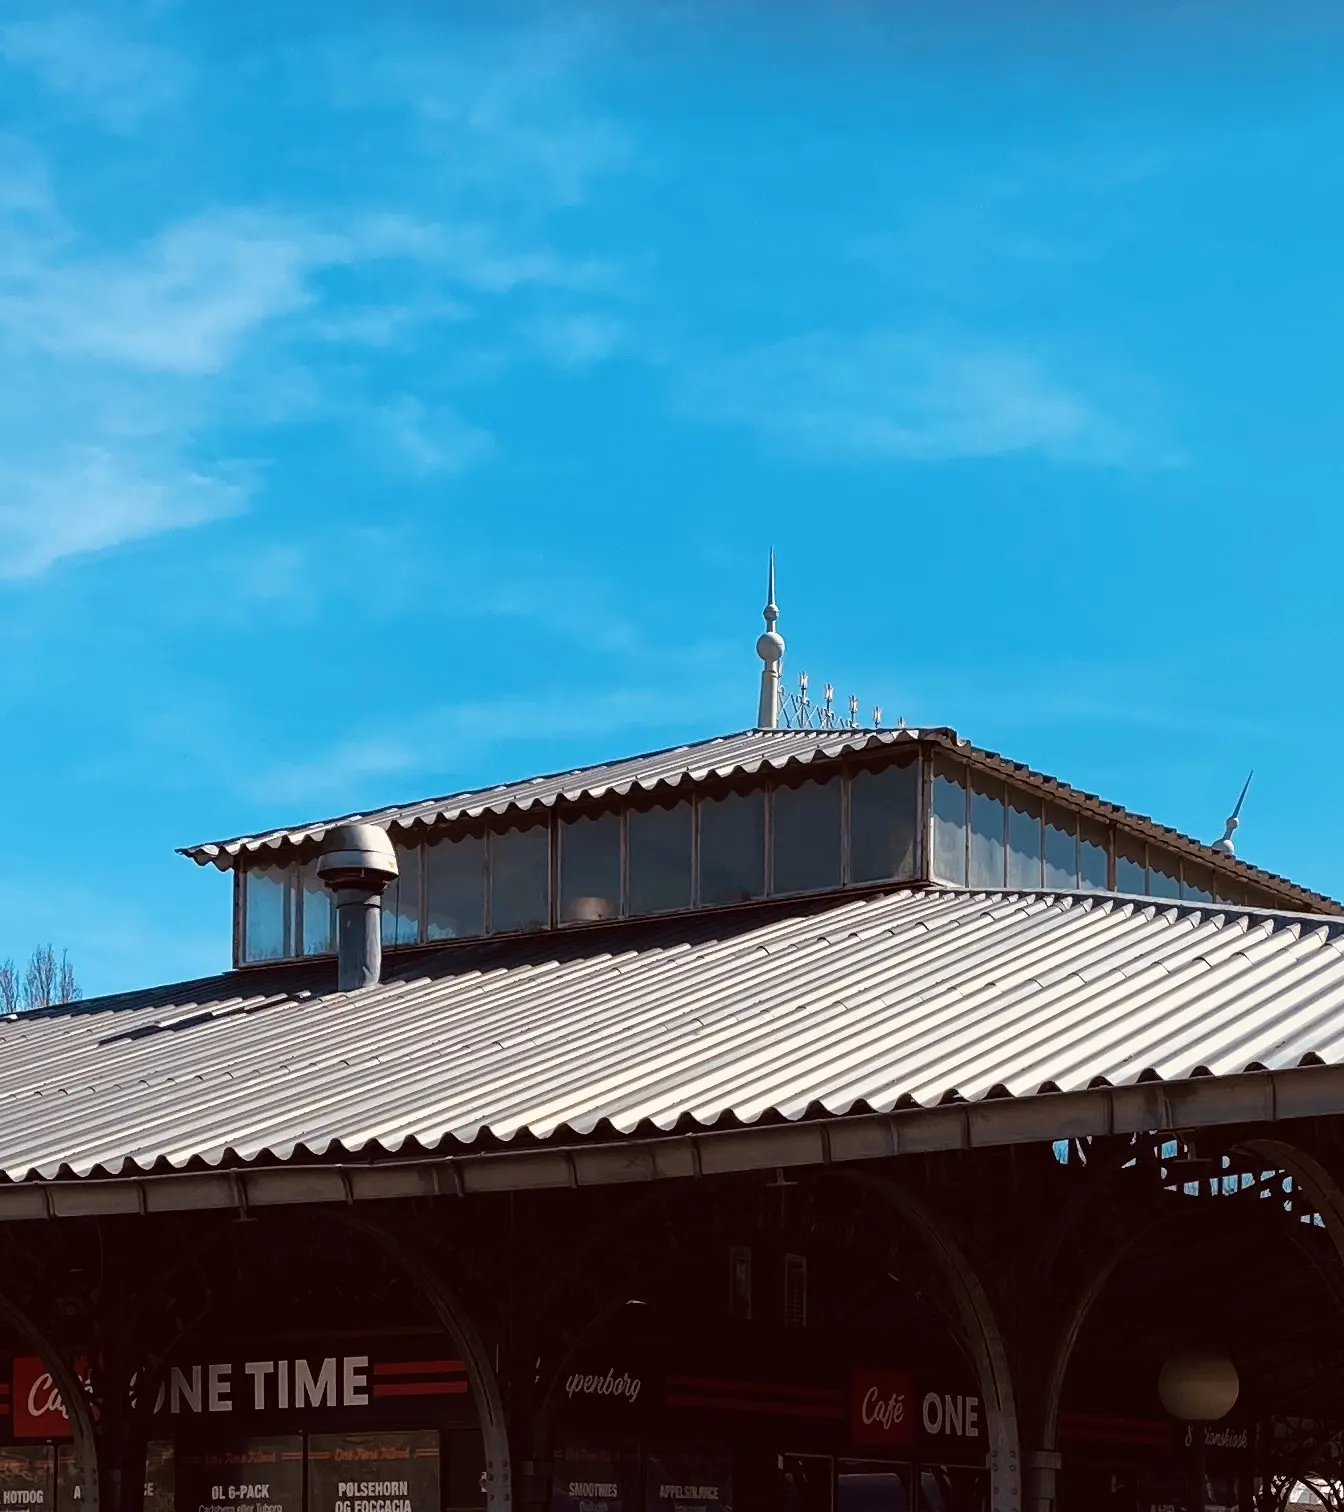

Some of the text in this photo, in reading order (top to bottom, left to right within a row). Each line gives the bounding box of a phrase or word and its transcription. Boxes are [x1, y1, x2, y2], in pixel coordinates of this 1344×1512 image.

[244, 1355, 369, 1411] TIME
[551, 1362, 642, 1404] penborg
[861, 1386, 980, 1437] Café ONE
[3, 1489, 44, 1505] HOTDOG
[212, 1483, 270, 1501] ØL 6-PACK
[338, 1480, 409, 1498] PØLSEHORN
[569, 1481, 618, 1498] SMOOTHIES
